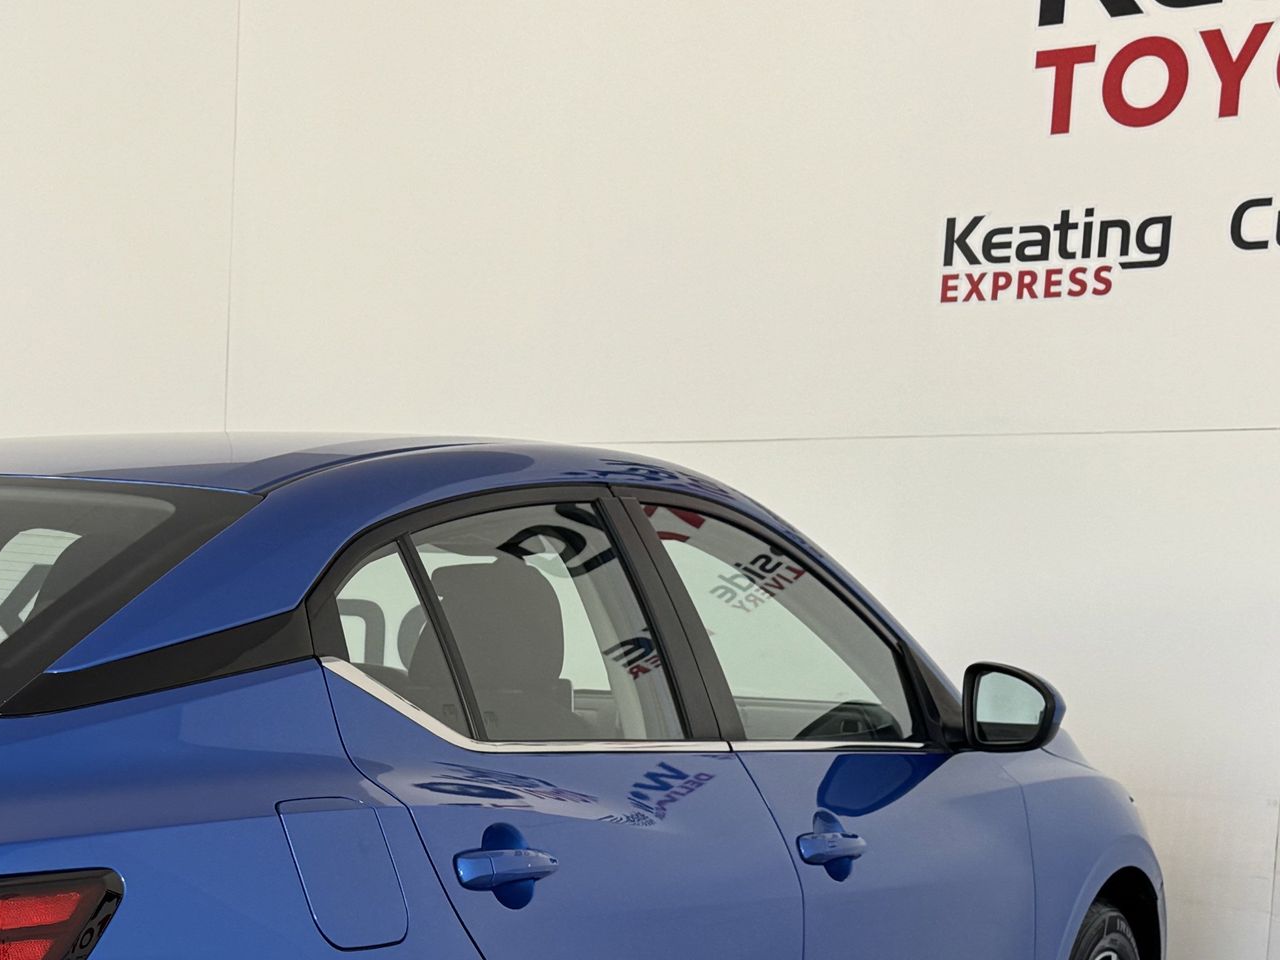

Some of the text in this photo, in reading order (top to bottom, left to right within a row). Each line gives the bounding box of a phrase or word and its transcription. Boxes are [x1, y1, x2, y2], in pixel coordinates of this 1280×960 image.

[1035, 21, 1280, 135] TOY
[942, 207, 1173, 269] Keating
[939, 265, 1113, 304] EXPRESS
